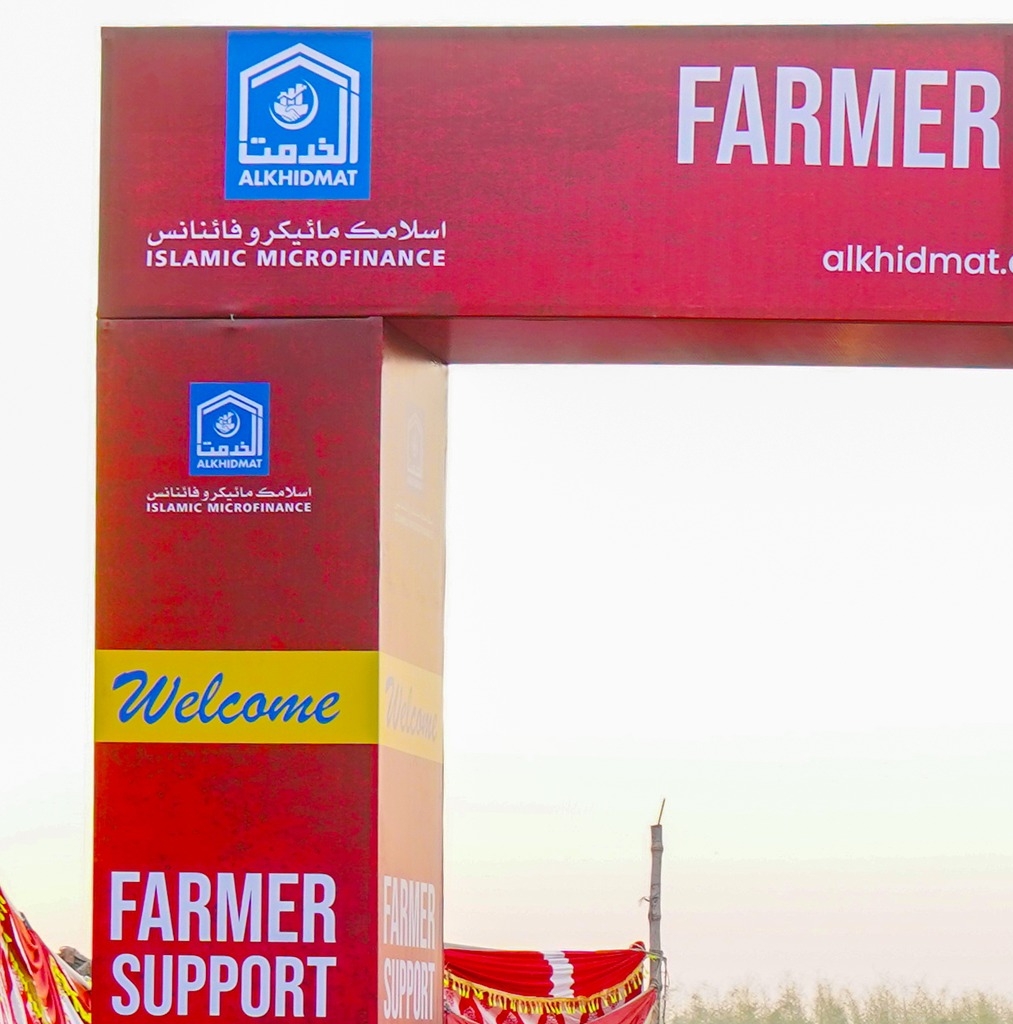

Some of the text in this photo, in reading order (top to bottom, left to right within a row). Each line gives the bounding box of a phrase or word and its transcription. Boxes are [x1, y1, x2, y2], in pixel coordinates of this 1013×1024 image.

[678, 67, 1000, 168] FARMER
[239, 170, 357, 186] ALKHIDMAT
[147, 250, 445, 267] ISLAMIC MICROFINANCE
[197, 459, 262, 468] ALKHIDMAT
[147, 503, 311, 512] ISLAMIC MICROFINANCE
[113, 670, 339, 724] Welcome
[111, 871, 336, 943] FARMER
[384, 876, 434, 949] FARMER
[112, 954, 336, 1017] SUPPORT
[384, 959, 435, 1019] SUPPORT
